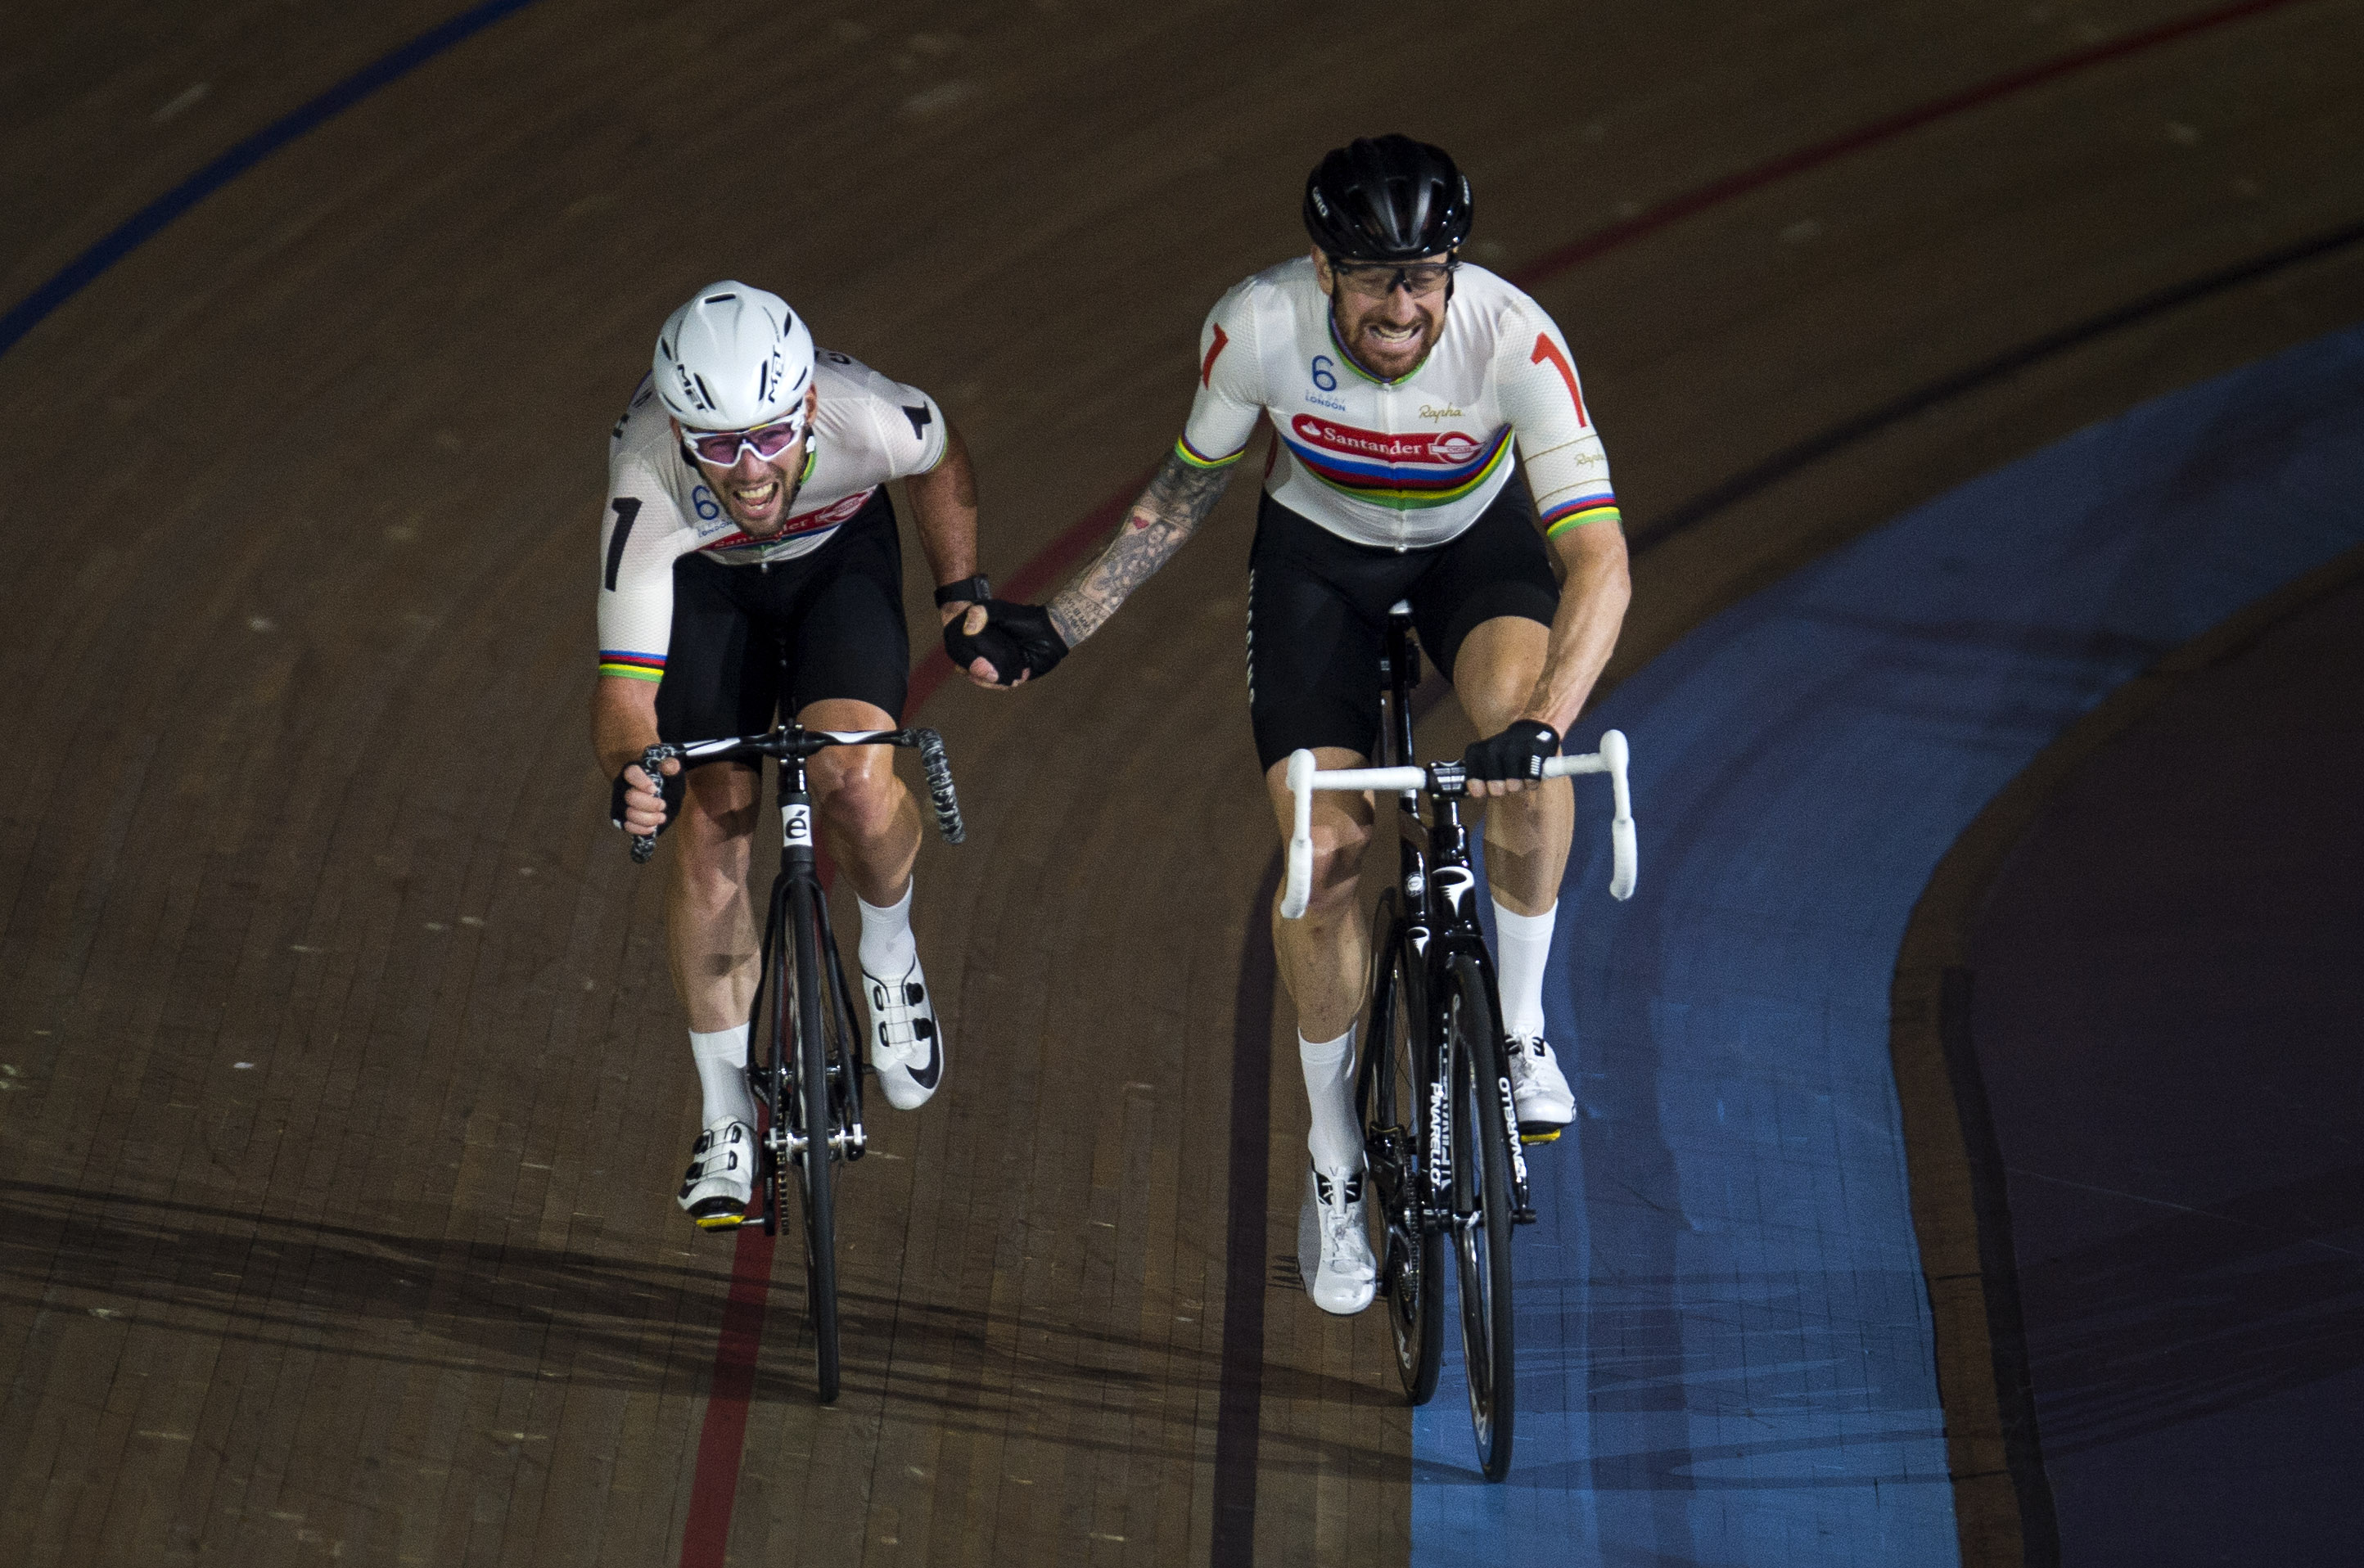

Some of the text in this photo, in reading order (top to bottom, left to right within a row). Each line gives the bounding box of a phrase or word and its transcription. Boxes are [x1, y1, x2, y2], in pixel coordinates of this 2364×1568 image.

[1311, 354, 1338, 391] 6
[1530, 331, 1587, 427] 1
[1305, 394, 1346, 412] LONDON
[1419, 403, 1463, 423] Rapha
[1323, 426, 1423, 455] Santander
[692, 484, 720, 520] 6
[604, 497, 643, 593] 1
[786, 809, 807, 840] é
[1430, 1081, 1444, 1185] PINARELLO
